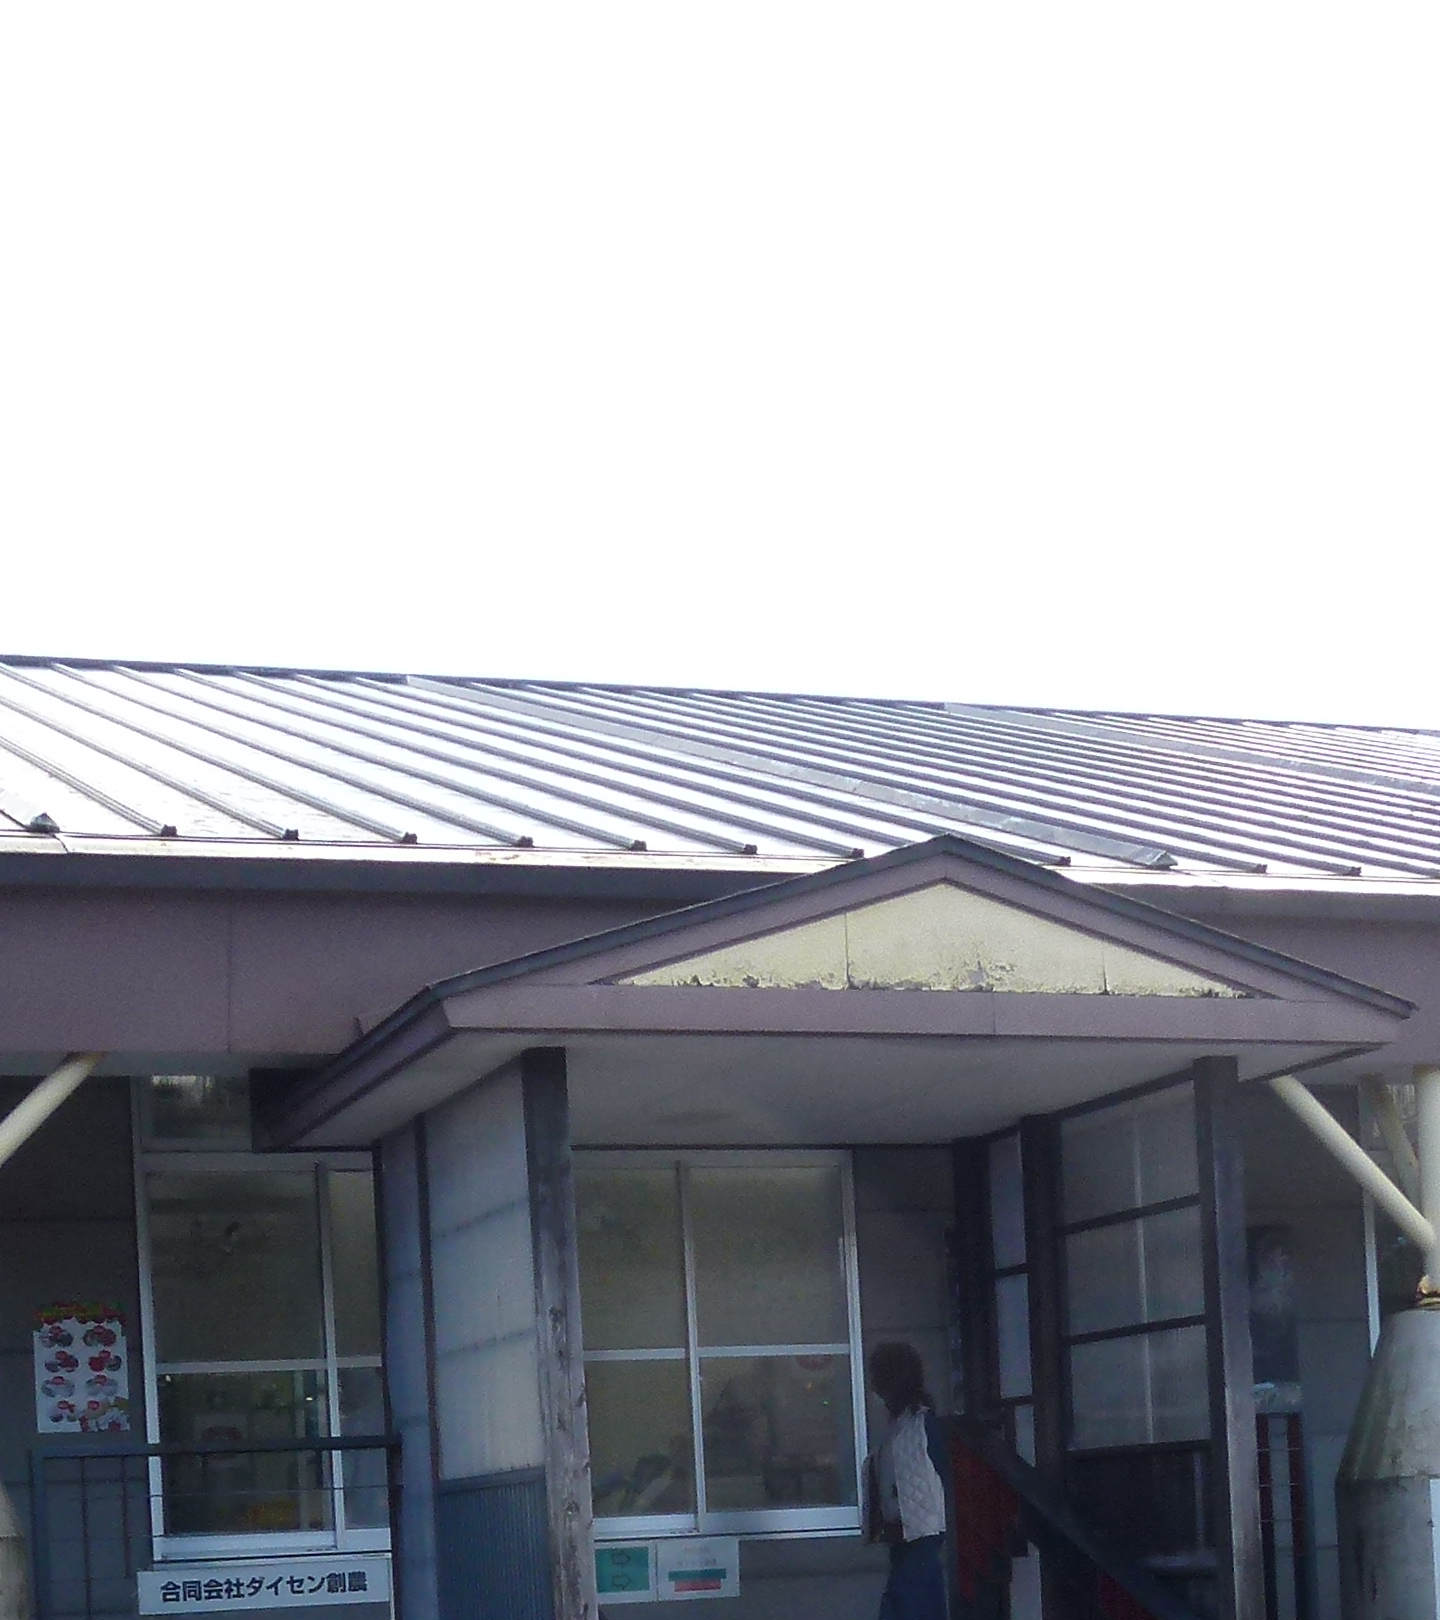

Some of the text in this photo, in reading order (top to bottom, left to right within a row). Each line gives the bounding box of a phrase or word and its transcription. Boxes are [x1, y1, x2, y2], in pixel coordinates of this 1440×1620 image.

[160, 1571, 368, 1602] 合同会社ダイセン創農
